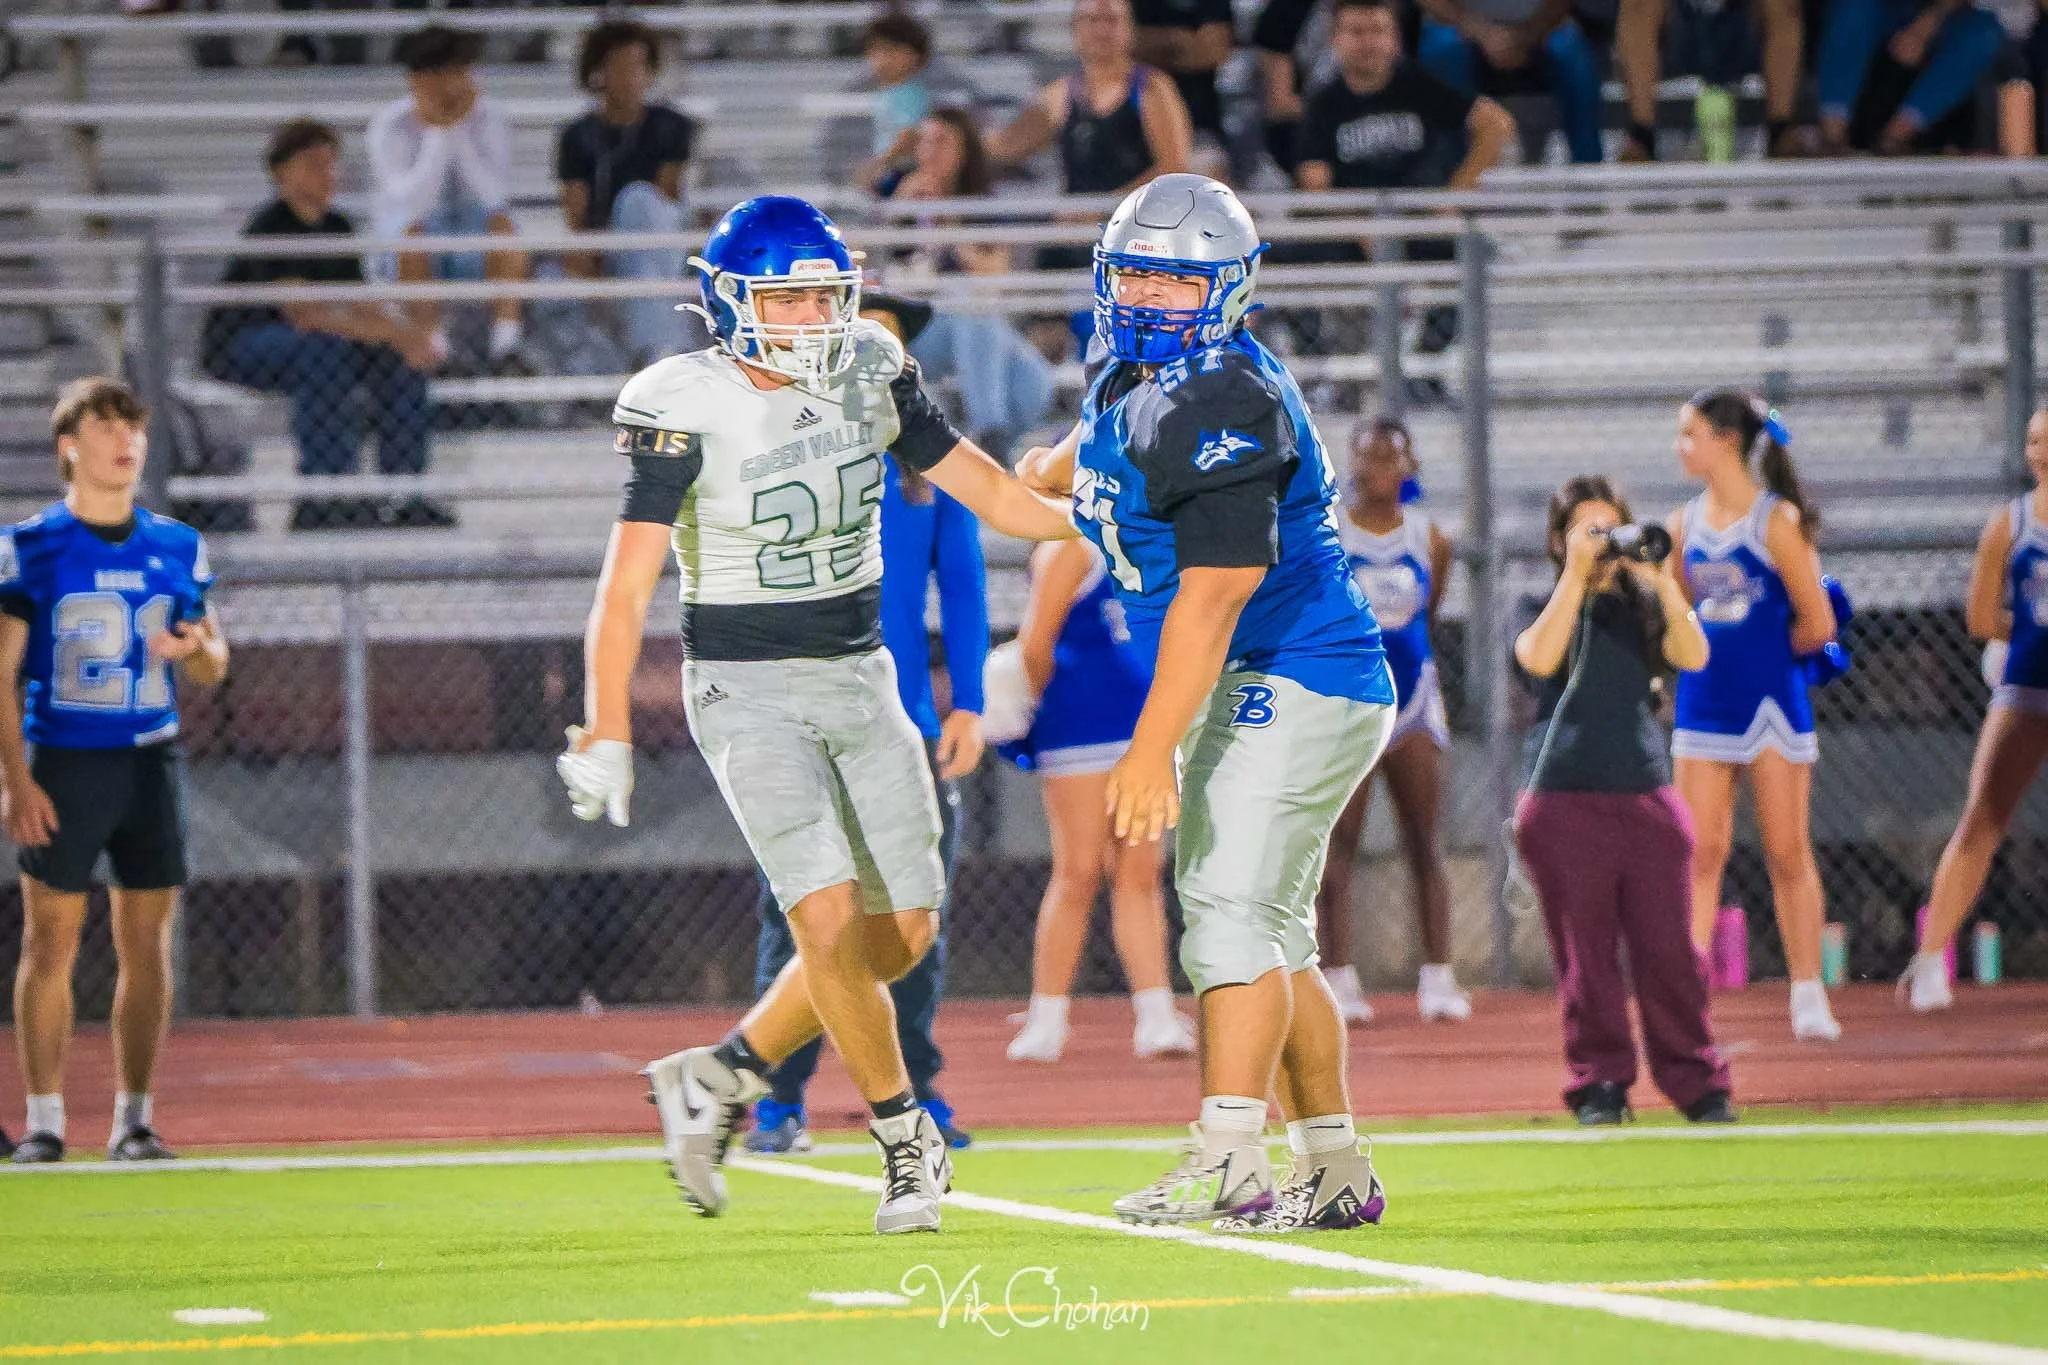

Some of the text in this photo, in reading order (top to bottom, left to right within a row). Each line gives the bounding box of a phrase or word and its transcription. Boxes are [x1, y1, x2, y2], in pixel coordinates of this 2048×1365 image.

[739, 439, 806, 482] GREEN
[752, 452, 882, 590] 25
[51, 591, 176, 712] 21
[1228, 682, 1278, 729] B
